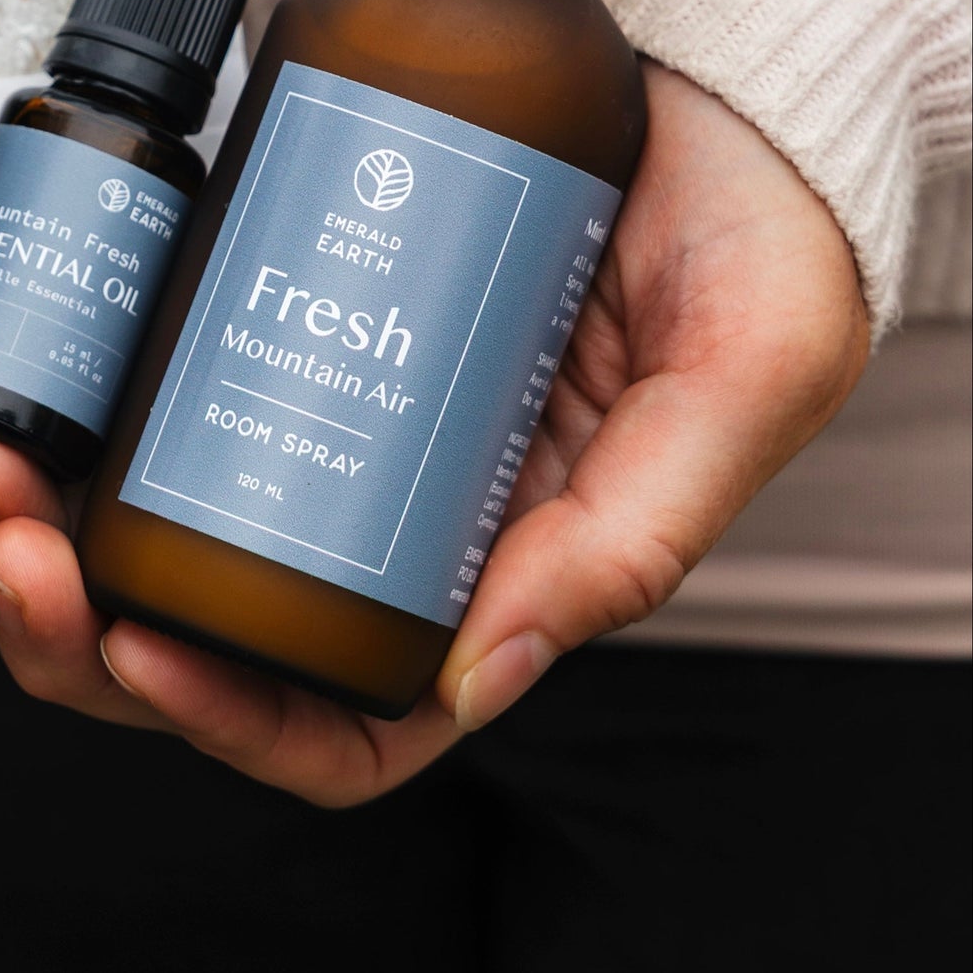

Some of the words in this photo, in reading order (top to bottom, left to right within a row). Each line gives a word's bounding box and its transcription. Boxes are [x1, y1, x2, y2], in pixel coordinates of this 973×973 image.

[130, 207, 173, 240] EARTH
[136, 191, 180, 223] EMERALD
[324, 212, 402, 251] EMERALD
[83, 232, 140, 274] Fresh
[316, 233, 394, 276] EARTH
[26, 279, 97, 319] Essential
[103, 277, 140, 317] OIL
[247, 265, 412, 367] Fresh
[48, 349, 74, 367] 0.05
[78, 363, 89, 376] fl
[92, 372, 103, 384] oz
[63, 341, 76, 354] 15
[220, 323, 363, 398] Mountain
[365, 382, 415, 415] Air
[521, 391, 532, 406] Do
[205, 403, 273, 444] ROOM
[281, 433, 365, 477] SPRAY
[237, 472, 260, 490] 120
[265, 482, 284, 501] ML
